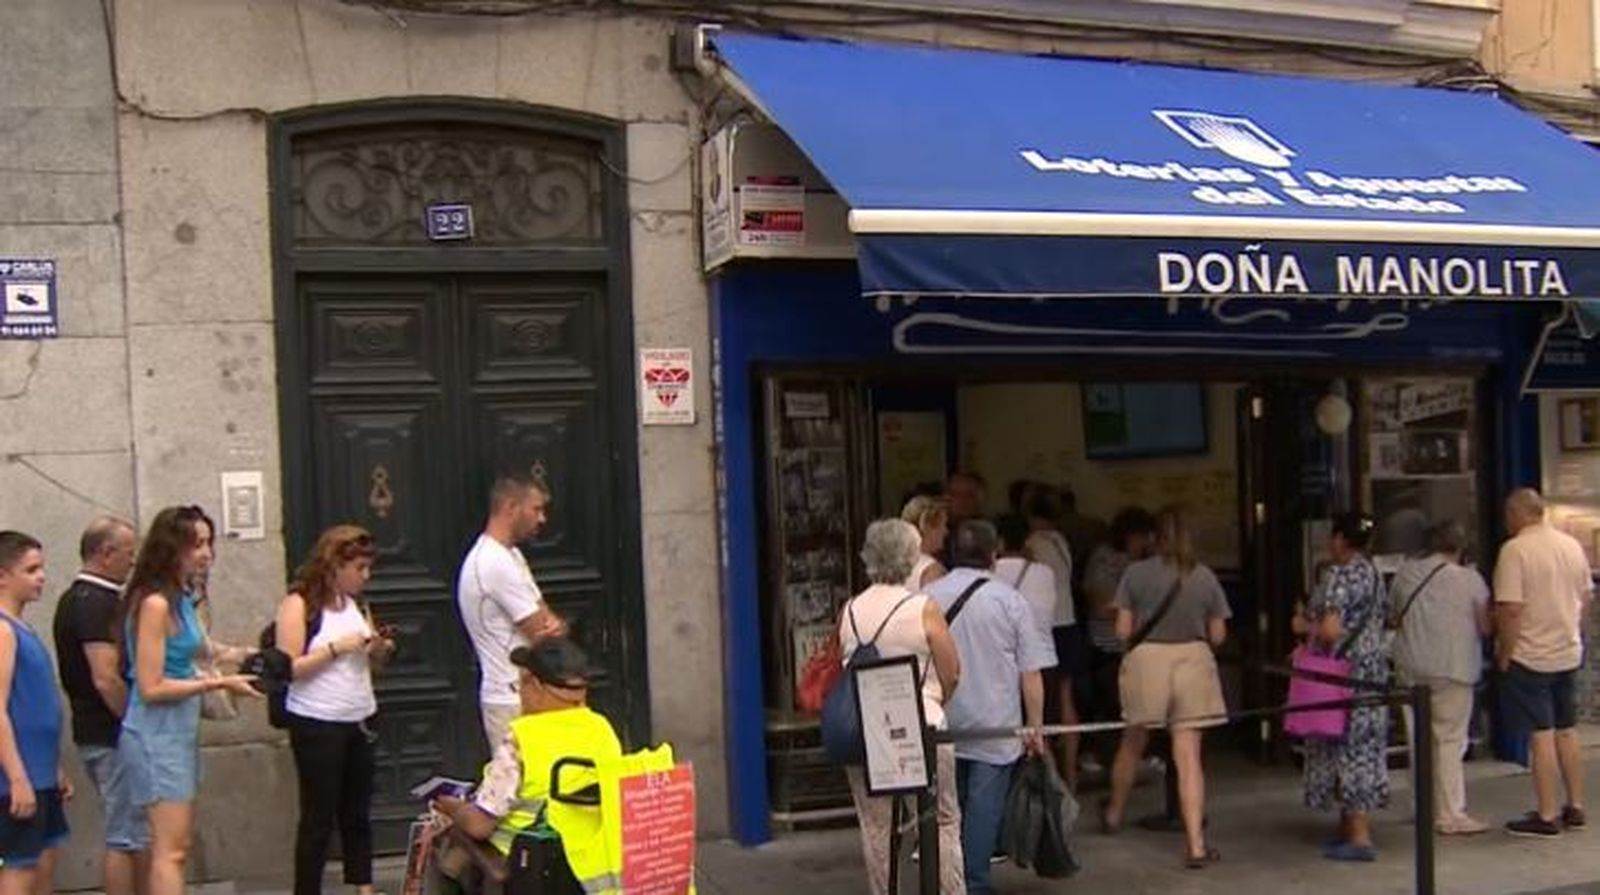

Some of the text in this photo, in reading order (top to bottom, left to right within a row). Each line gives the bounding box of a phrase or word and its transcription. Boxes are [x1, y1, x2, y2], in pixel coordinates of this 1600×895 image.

[1304, 170, 1528, 194] Apuestas
[1191, 185, 1467, 213] del Estado
[435, 212, 463, 232] 22
[1158, 243, 1569, 296] DOÑA MANOLITA
